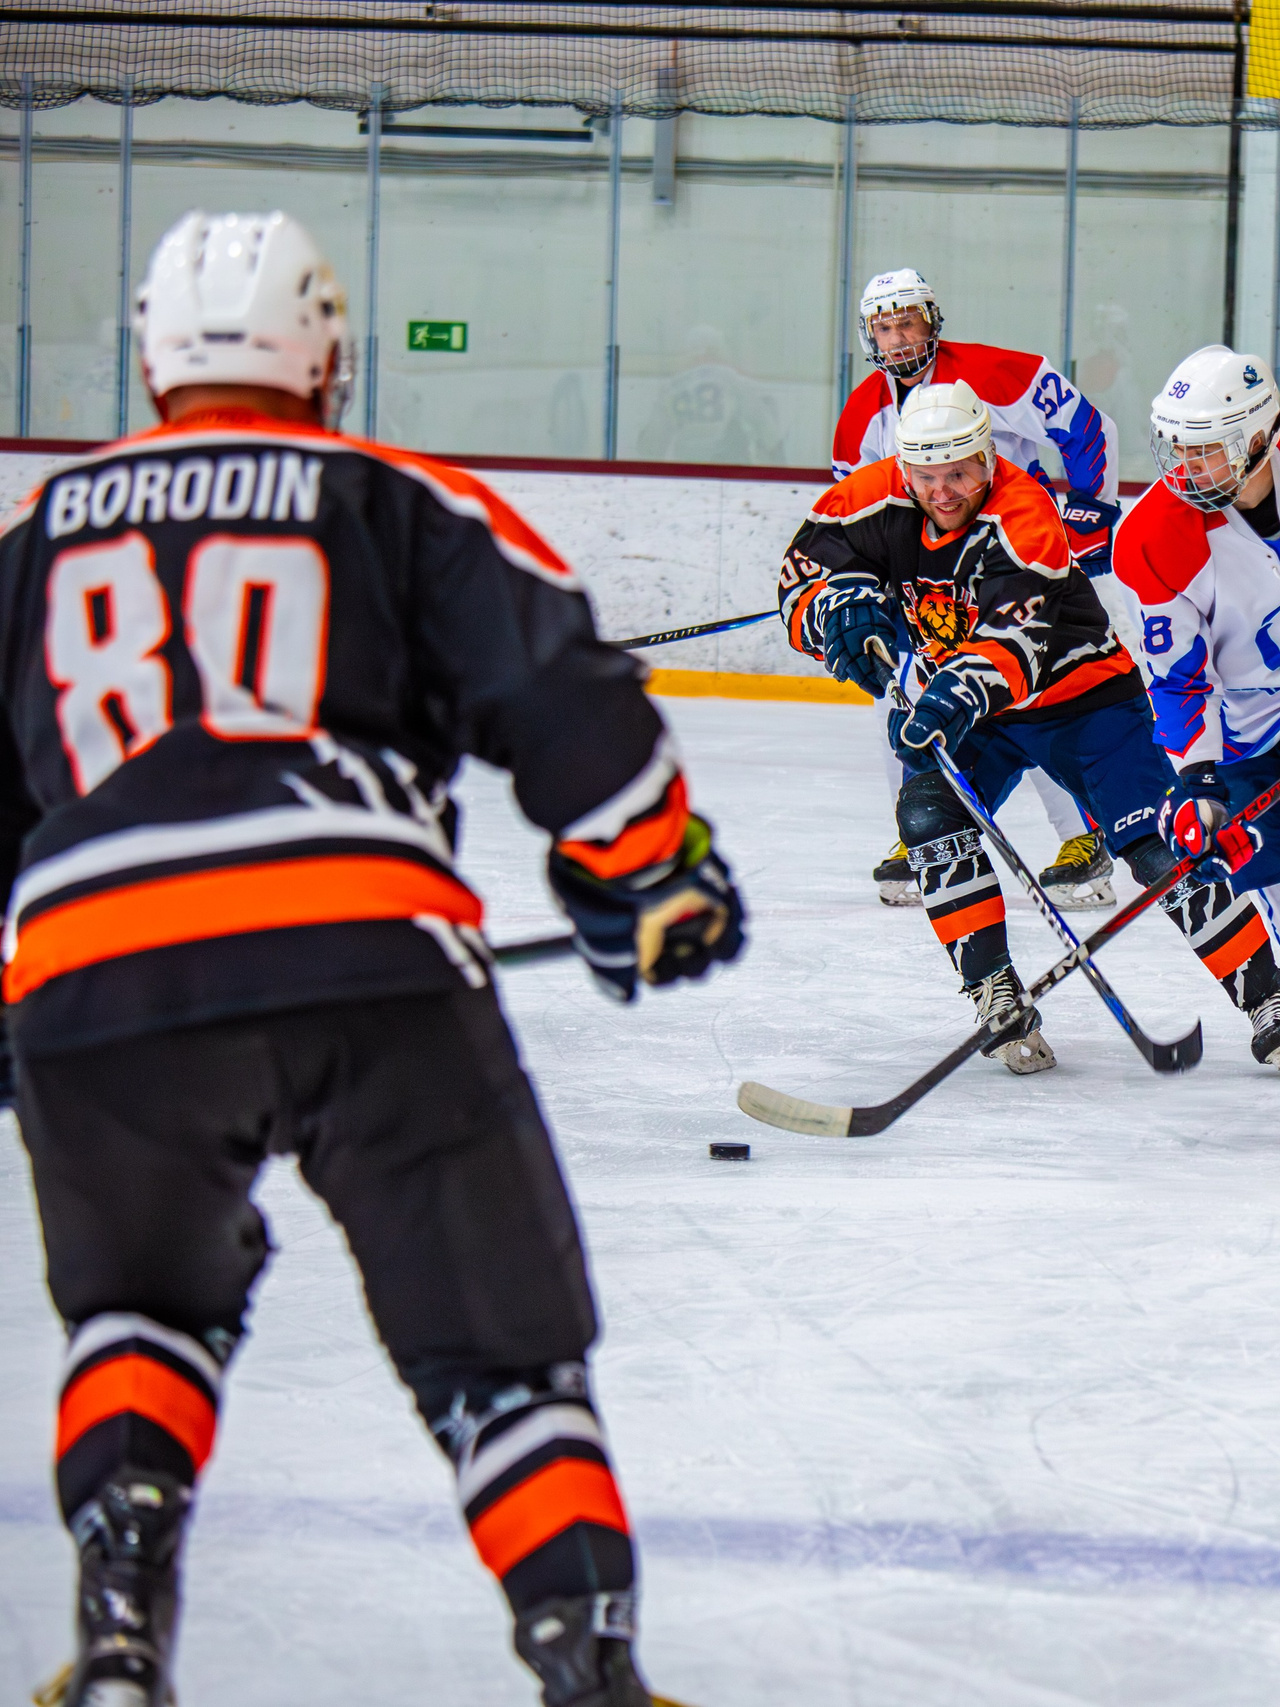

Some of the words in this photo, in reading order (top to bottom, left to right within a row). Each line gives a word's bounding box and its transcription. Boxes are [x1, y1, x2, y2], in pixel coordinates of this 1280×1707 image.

[877, 277, 894, 286] 52
[1032, 372, 1075, 420] 52
[1168, 381, 1190, 400] 98
[1248, 394, 1272, 415] BAUER
[46, 453, 323, 539] BORODIN
[648, 627, 700, 644] FLYLITE
[1139, 609, 1174, 656] 8
[46, 530, 331, 797] 80
